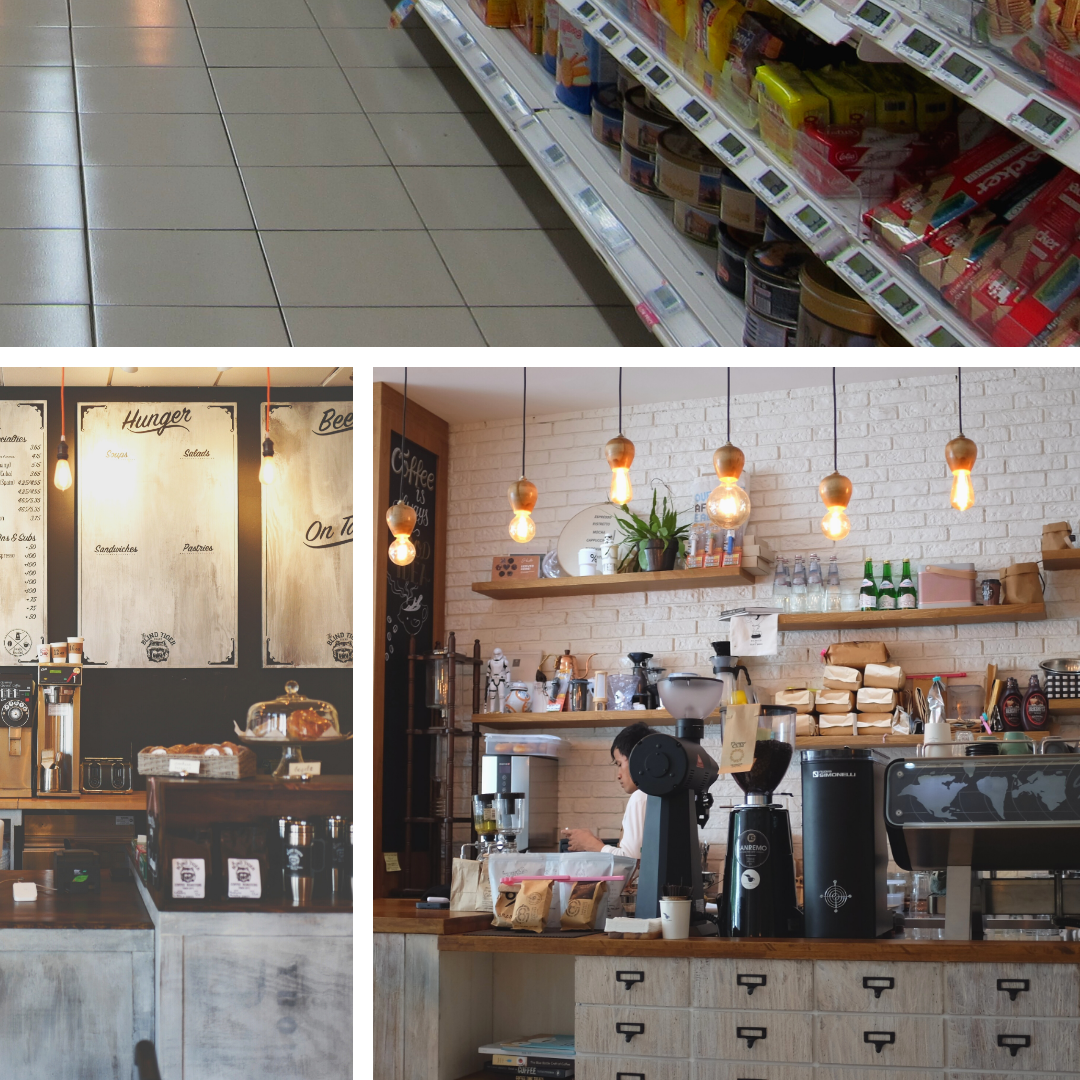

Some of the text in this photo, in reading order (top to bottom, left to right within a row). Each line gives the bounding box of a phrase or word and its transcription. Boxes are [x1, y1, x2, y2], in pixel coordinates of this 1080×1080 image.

[121, 407, 192, 436] Hunger
[105, 450, 129, 460] Soups
[183, 448, 211, 459] Salads
[390, 446, 436, 491] Coffee
[416, 487, 426, 505] is
[18, 532, 37, 542] Subs
[305, 520, 334, 542] On
[94, 543, 139, 554] Sandwiches
[182, 543, 214, 553] Pastries
[160, 631, 177, 646] TIGER
